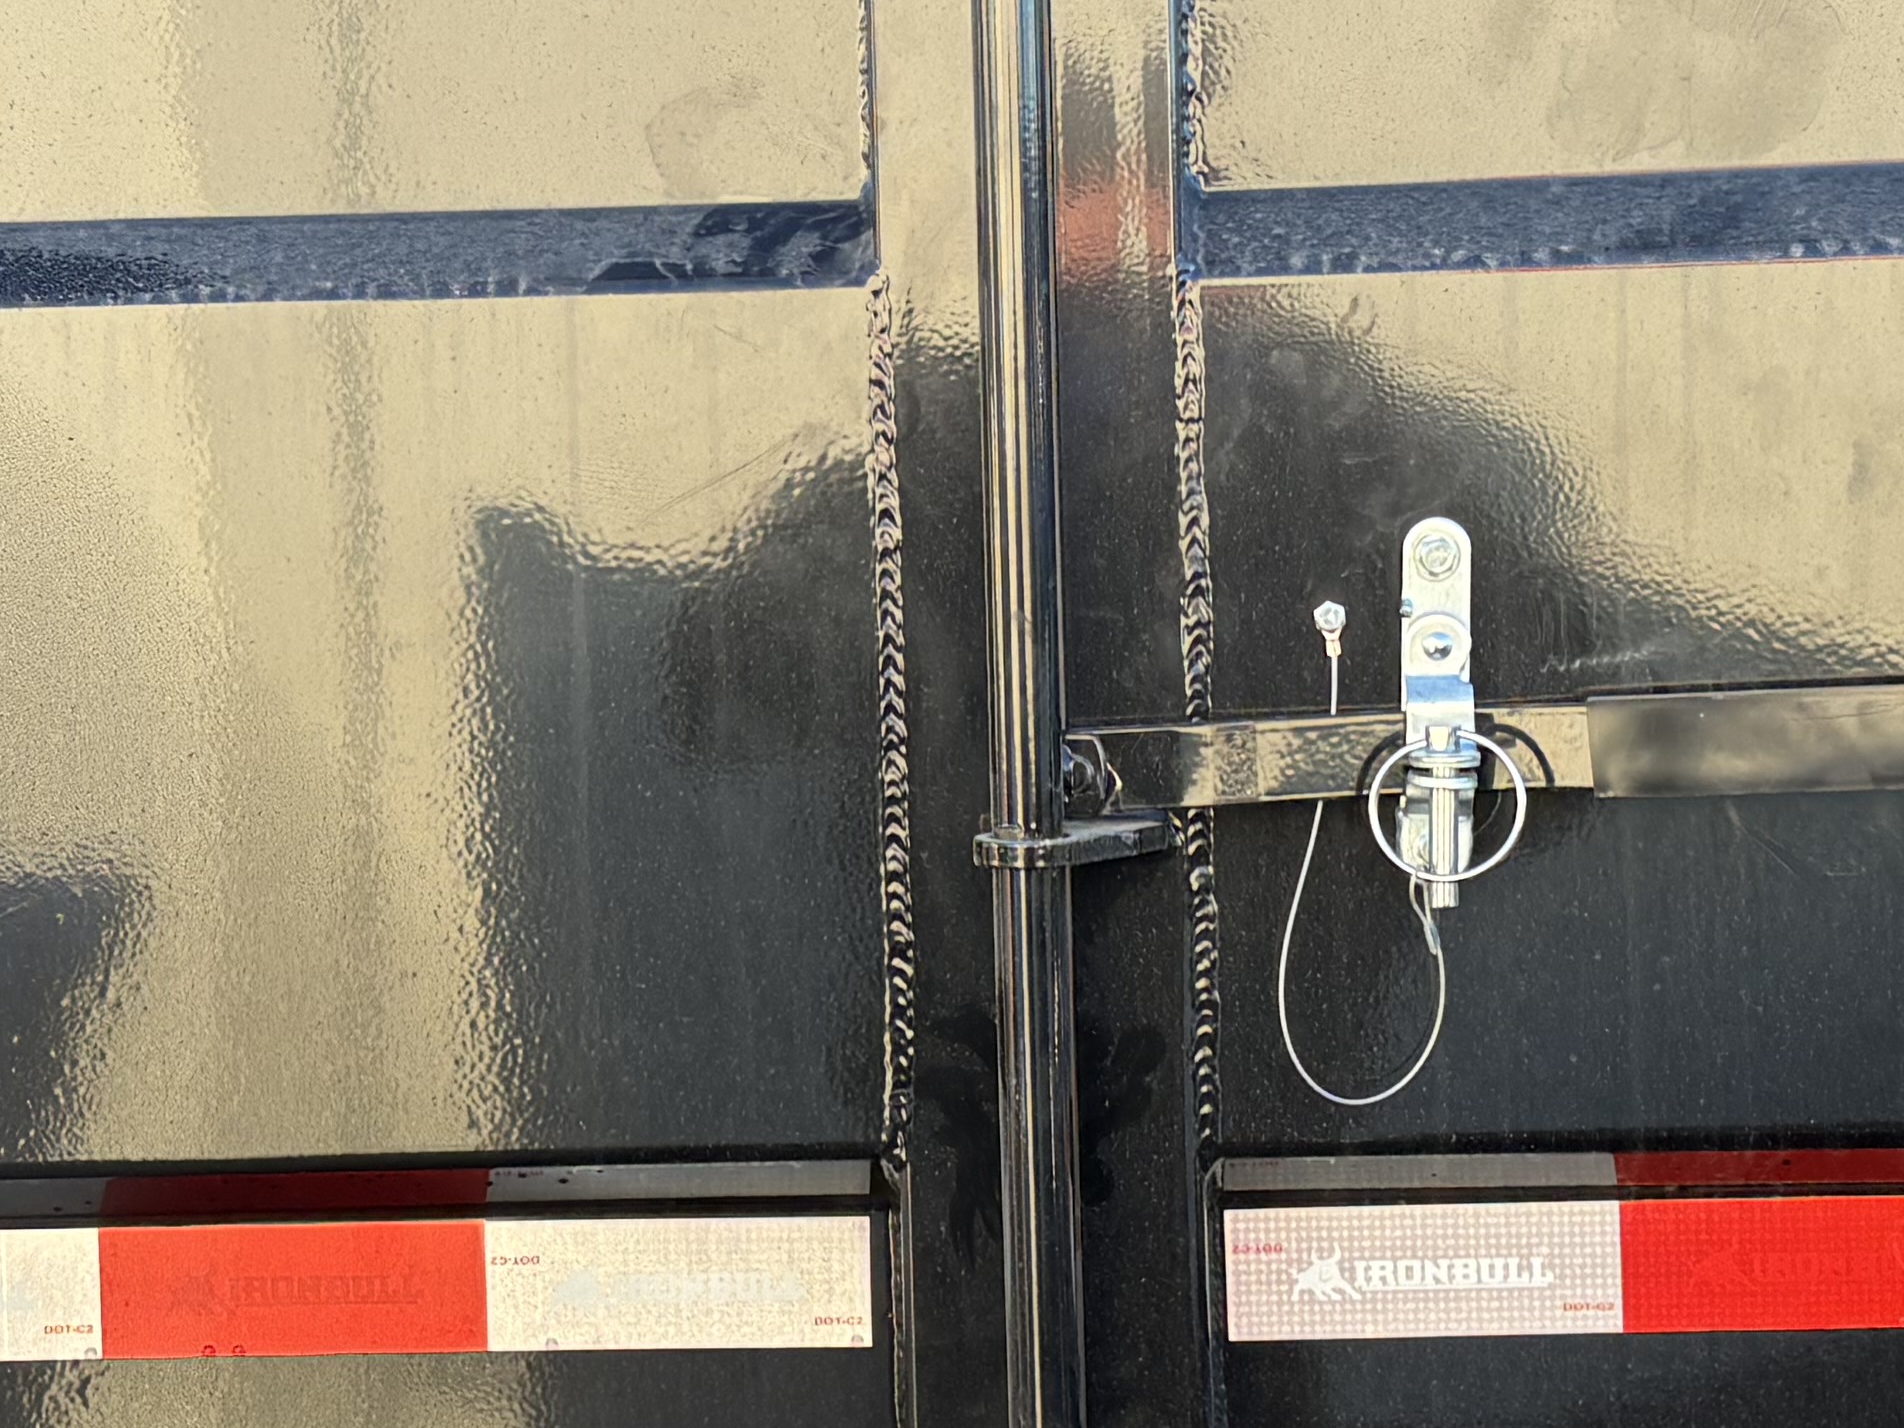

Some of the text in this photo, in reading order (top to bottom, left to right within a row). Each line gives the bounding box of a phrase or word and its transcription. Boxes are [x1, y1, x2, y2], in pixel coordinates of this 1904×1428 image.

[1232, 1243, 1283, 1254] DOT-C2
[491, 1255, 540, 1266] DOT-C2
[1355, 1256, 1553, 1287] IRONBULL
[1562, 1302, 1615, 1312] DOT-C2
[814, 1316, 864, 1327] DOT-C2
[44, 1324, 94, 1335] DOT-C2
